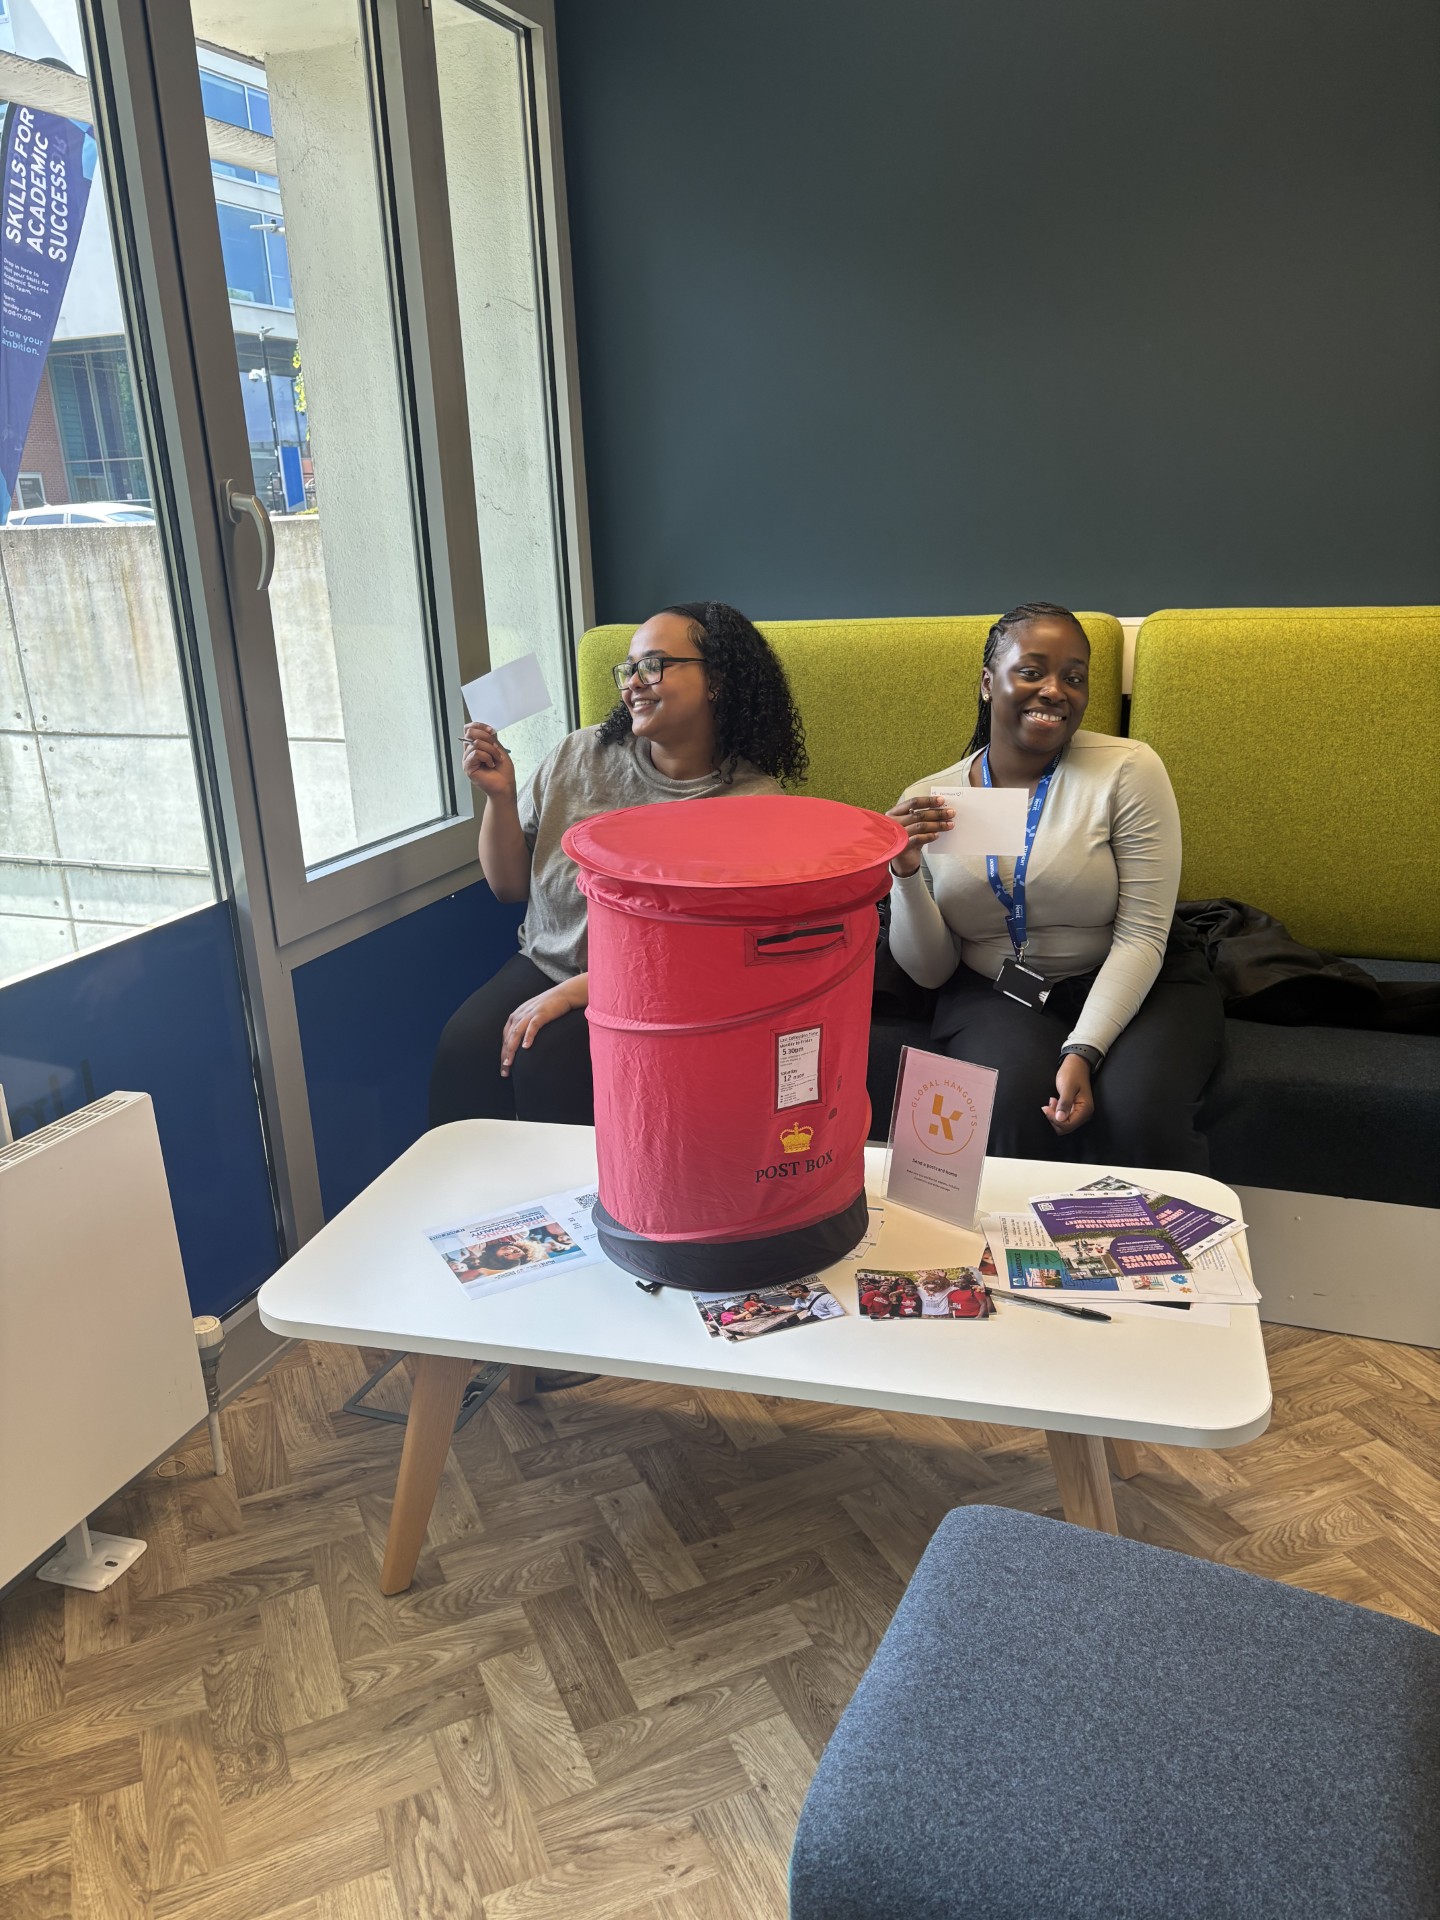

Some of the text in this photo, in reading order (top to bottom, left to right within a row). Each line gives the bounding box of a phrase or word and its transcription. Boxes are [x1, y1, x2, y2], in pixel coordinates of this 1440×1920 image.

[6, 107, 35, 244] SKILLS FOR
[26, 132, 49, 255] ACADEMIC
[48, 160, 68, 262] SUCCESS.
[13, 271, 25, 279] your
[26, 275, 40, 285] Skills
[21, 266, 32, 275] here
[4, 272, 48, 294] Academic Success
[25, 308, 41, 319] Friday
[2, 338, 39, 355] ambition.
[23, 335, 43, 346] your
[1032, 798, 1040, 811] Kent
[782, 1046, 804, 1055] 5.30pm
[911, 1079, 978, 1128] GLOBAL HANGOUTS
[755, 1149, 833, 1183] POST BOX
[912, 1158, 922, 1166] Send
[927, 1163, 945, 1173] postcard
[476, 1217, 548, 1240] PRACTISING
[1118, 1252, 1174, 1263] YOUR NSS.
